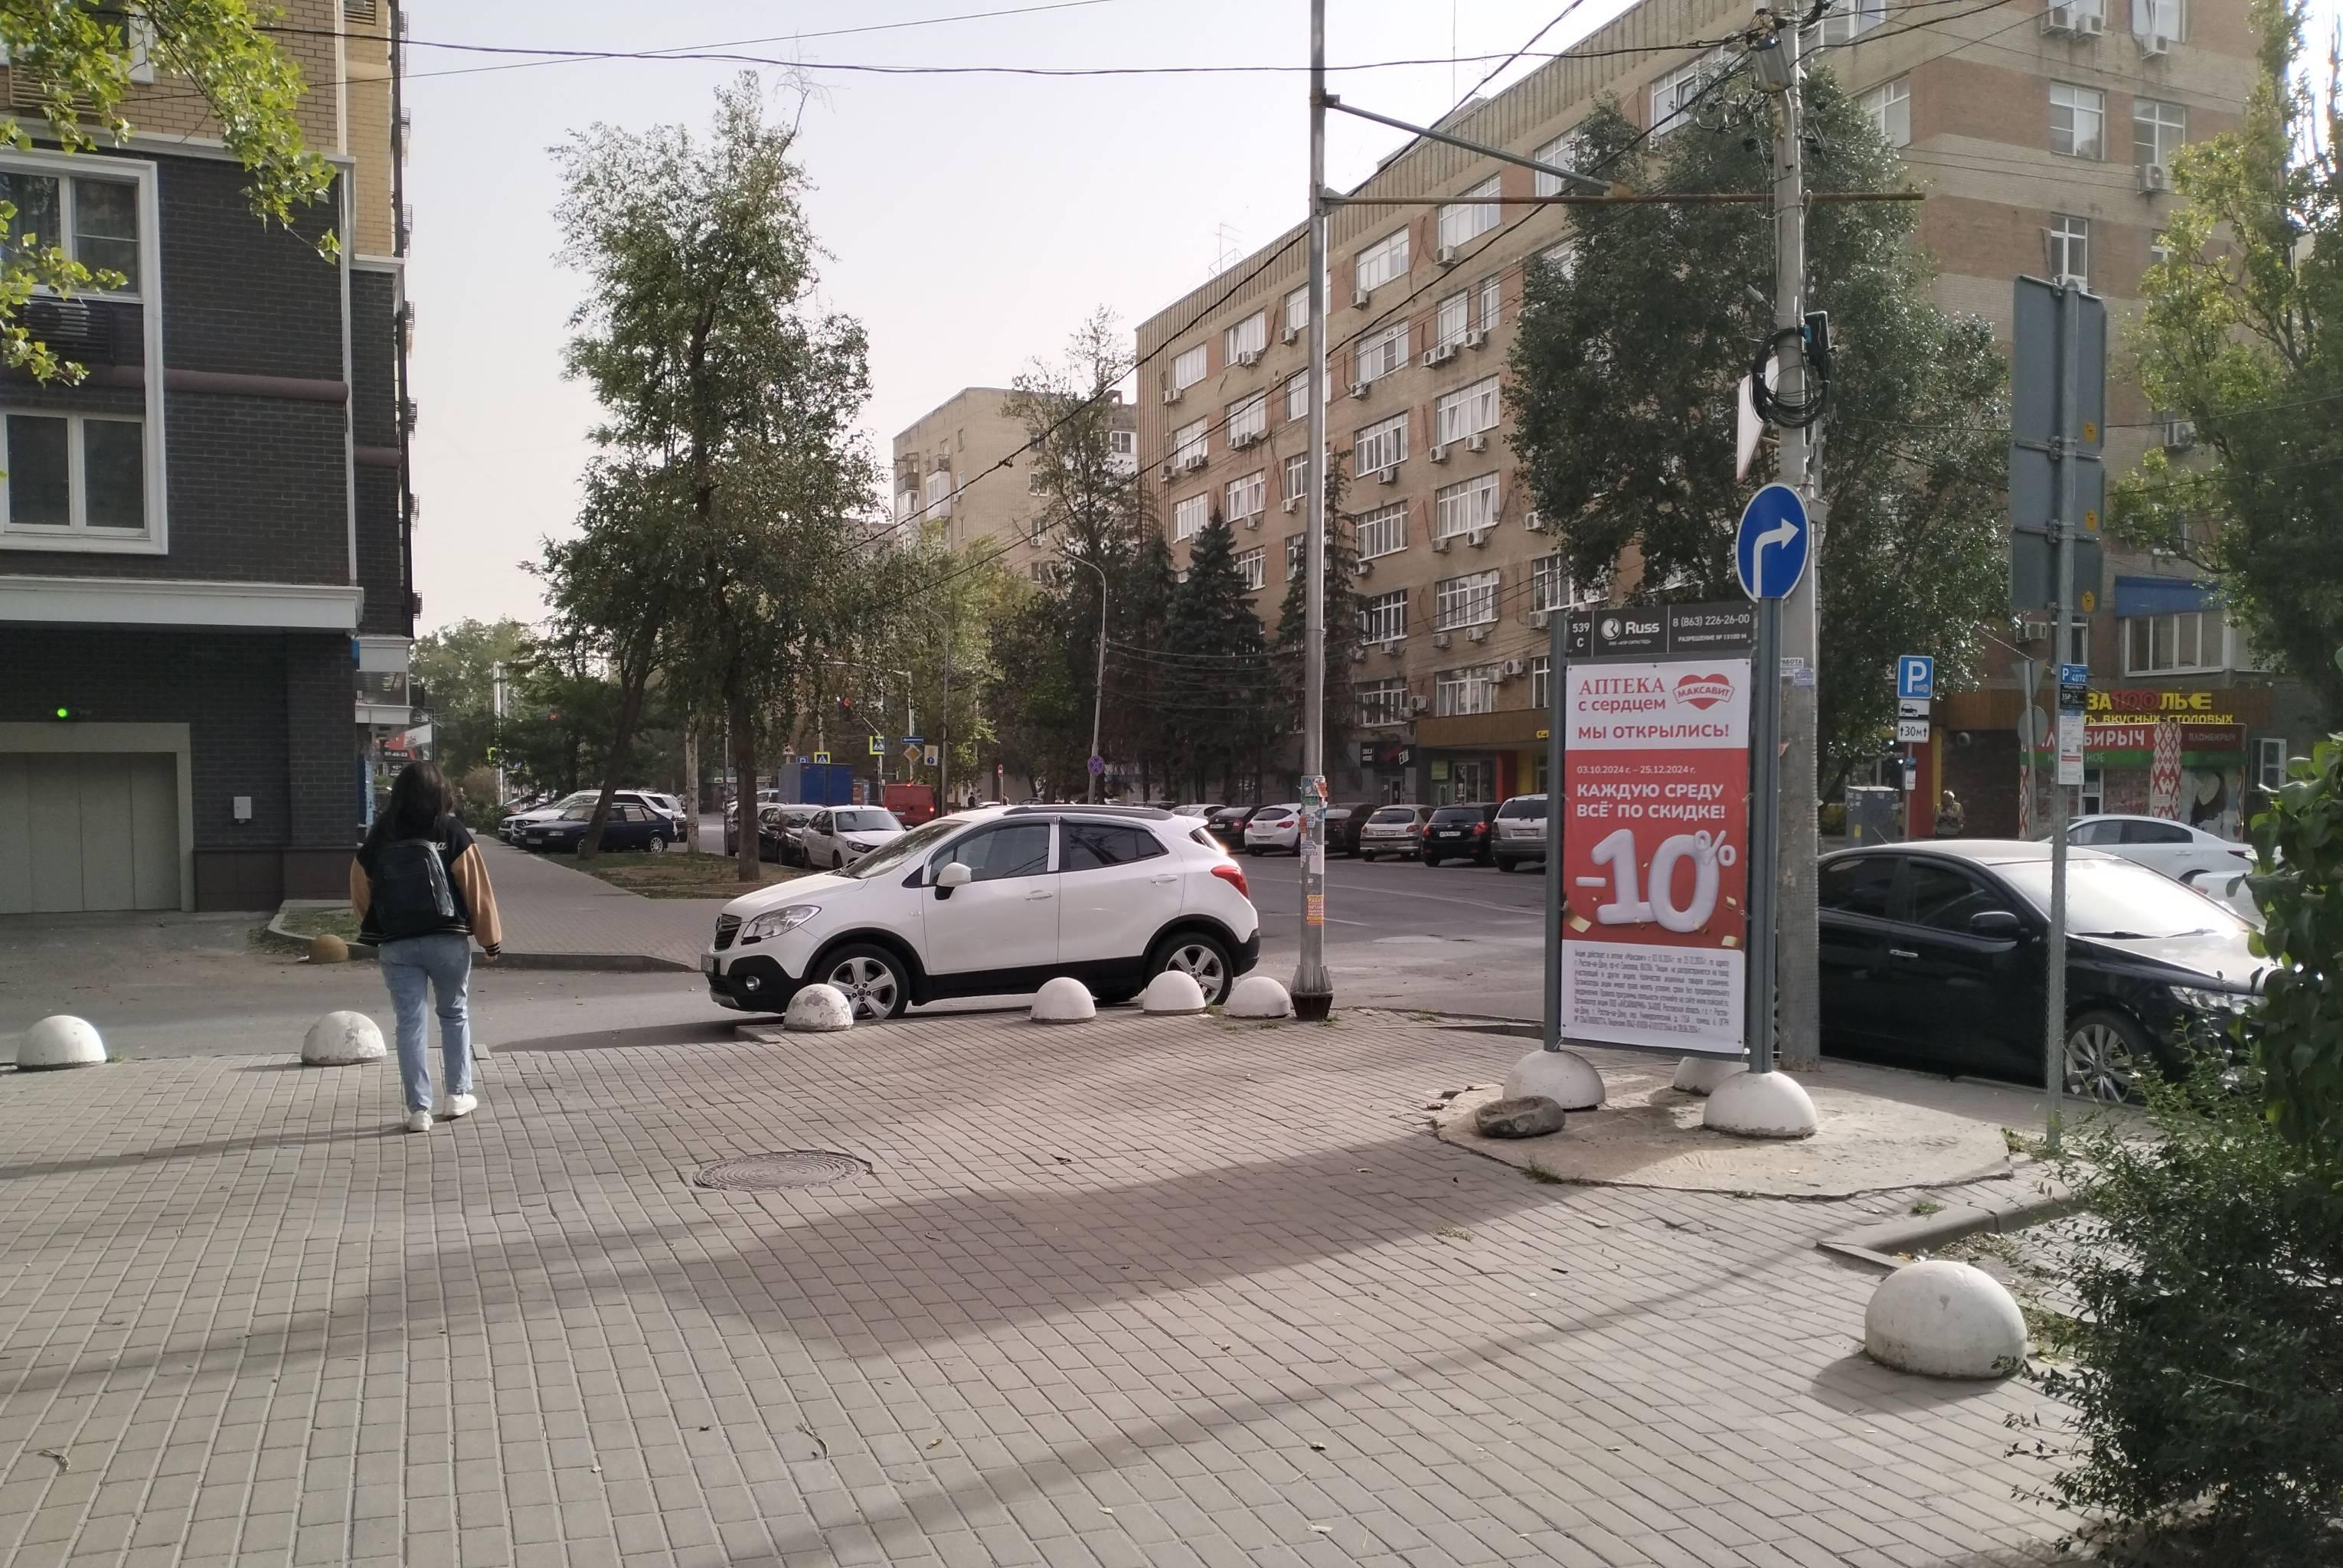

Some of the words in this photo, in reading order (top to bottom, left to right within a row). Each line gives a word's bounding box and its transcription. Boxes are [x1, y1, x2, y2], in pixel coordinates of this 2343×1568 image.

[1572, 622, 1590, 634] 539
[1626, 621, 1660, 635] Russ
[1672, 618, 1678, 628] 8
[1681, 617, 1703, 628] (863)
[1705, 614, 1750, 626] 226-26-00
[1579, 677, 1665, 695] АПТЕКА
[1677, 685, 1730, 699] МАКСАВИТ
[1591, 697, 1666, 714] сердцем
[2103, 714, 2160, 724] ВКУСНЫХ
[2167, 714, 2234, 724] СТОЛОВЫХ
[1578, 727, 1606, 740] МЫ
[1613, 724, 1729, 739] ОТКРЫЛИСЬ!
[1577, 766, 1624, 774] 03.10.2024
[1640, 766, 1688, 774] 25.12.2024
[1577, 784, 1659, 800] КАЖДУЮ
[1665, 784, 1724, 800] СРЕДУ
[1617, 805, 1643, 818] ПО
[1647, 805, 1725, 821] СКИДКЕ!
